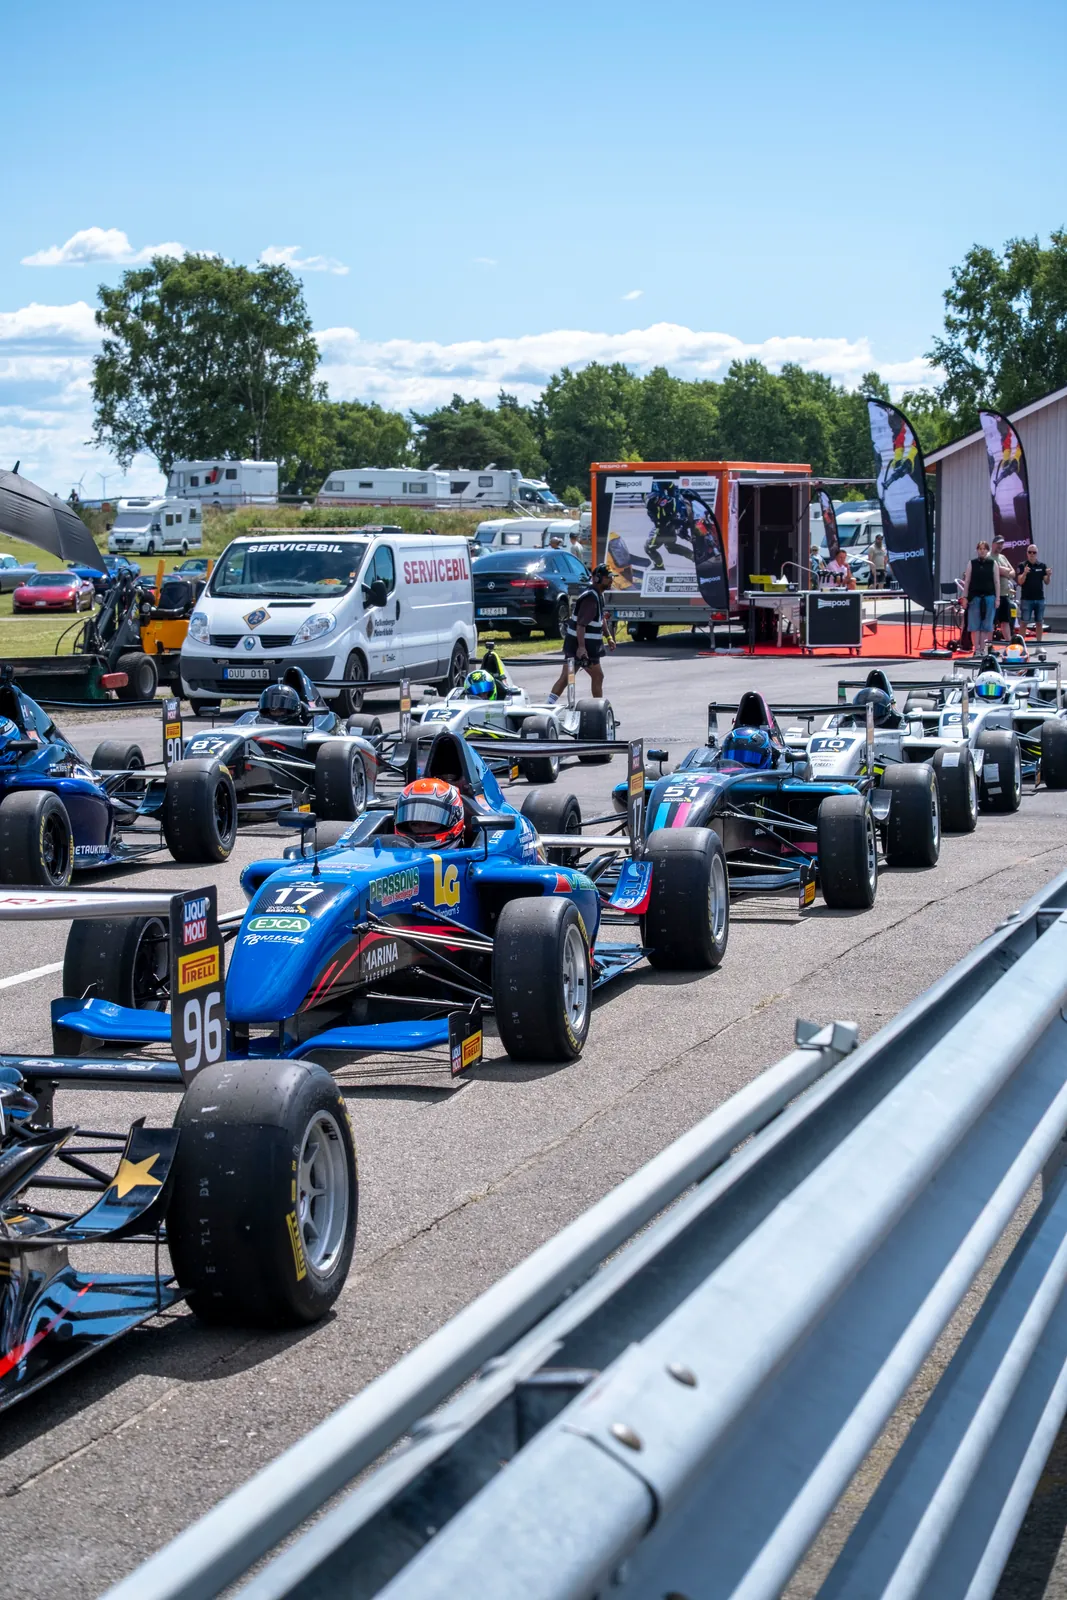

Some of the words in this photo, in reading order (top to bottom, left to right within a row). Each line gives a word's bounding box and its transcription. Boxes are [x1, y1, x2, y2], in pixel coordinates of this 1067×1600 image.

[626, 480, 642, 488] paoli
[247, 543, 343, 553] SERVICEBIL
[904, 548, 925, 561] paoli
[403, 558, 469, 584] SERVICEBIL
[830, 599, 851, 607] paoli
[250, 669, 268, 678] 019
[431, 711, 453, 719] 12
[402, 712, 411, 737] 87
[167, 737, 182, 768] 90
[190, 740, 226, 750] 87
[818, 740, 846, 748] 10
[662, 786, 701, 797] 51
[632, 797, 643, 837] 17
[369, 866, 420, 905] PERSSONS
[274, 887, 324, 905] 17
[185, 899, 206, 922] LIQUI
[185, 921, 207, 944] MOLY
[255, 919, 302, 930] EJCA
[362, 942, 399, 973] MARINA
[182, 953, 216, 985] PIRELLI
[365, 964, 396, 983] RACEWEAR
[183, 991, 222, 1072] 96
